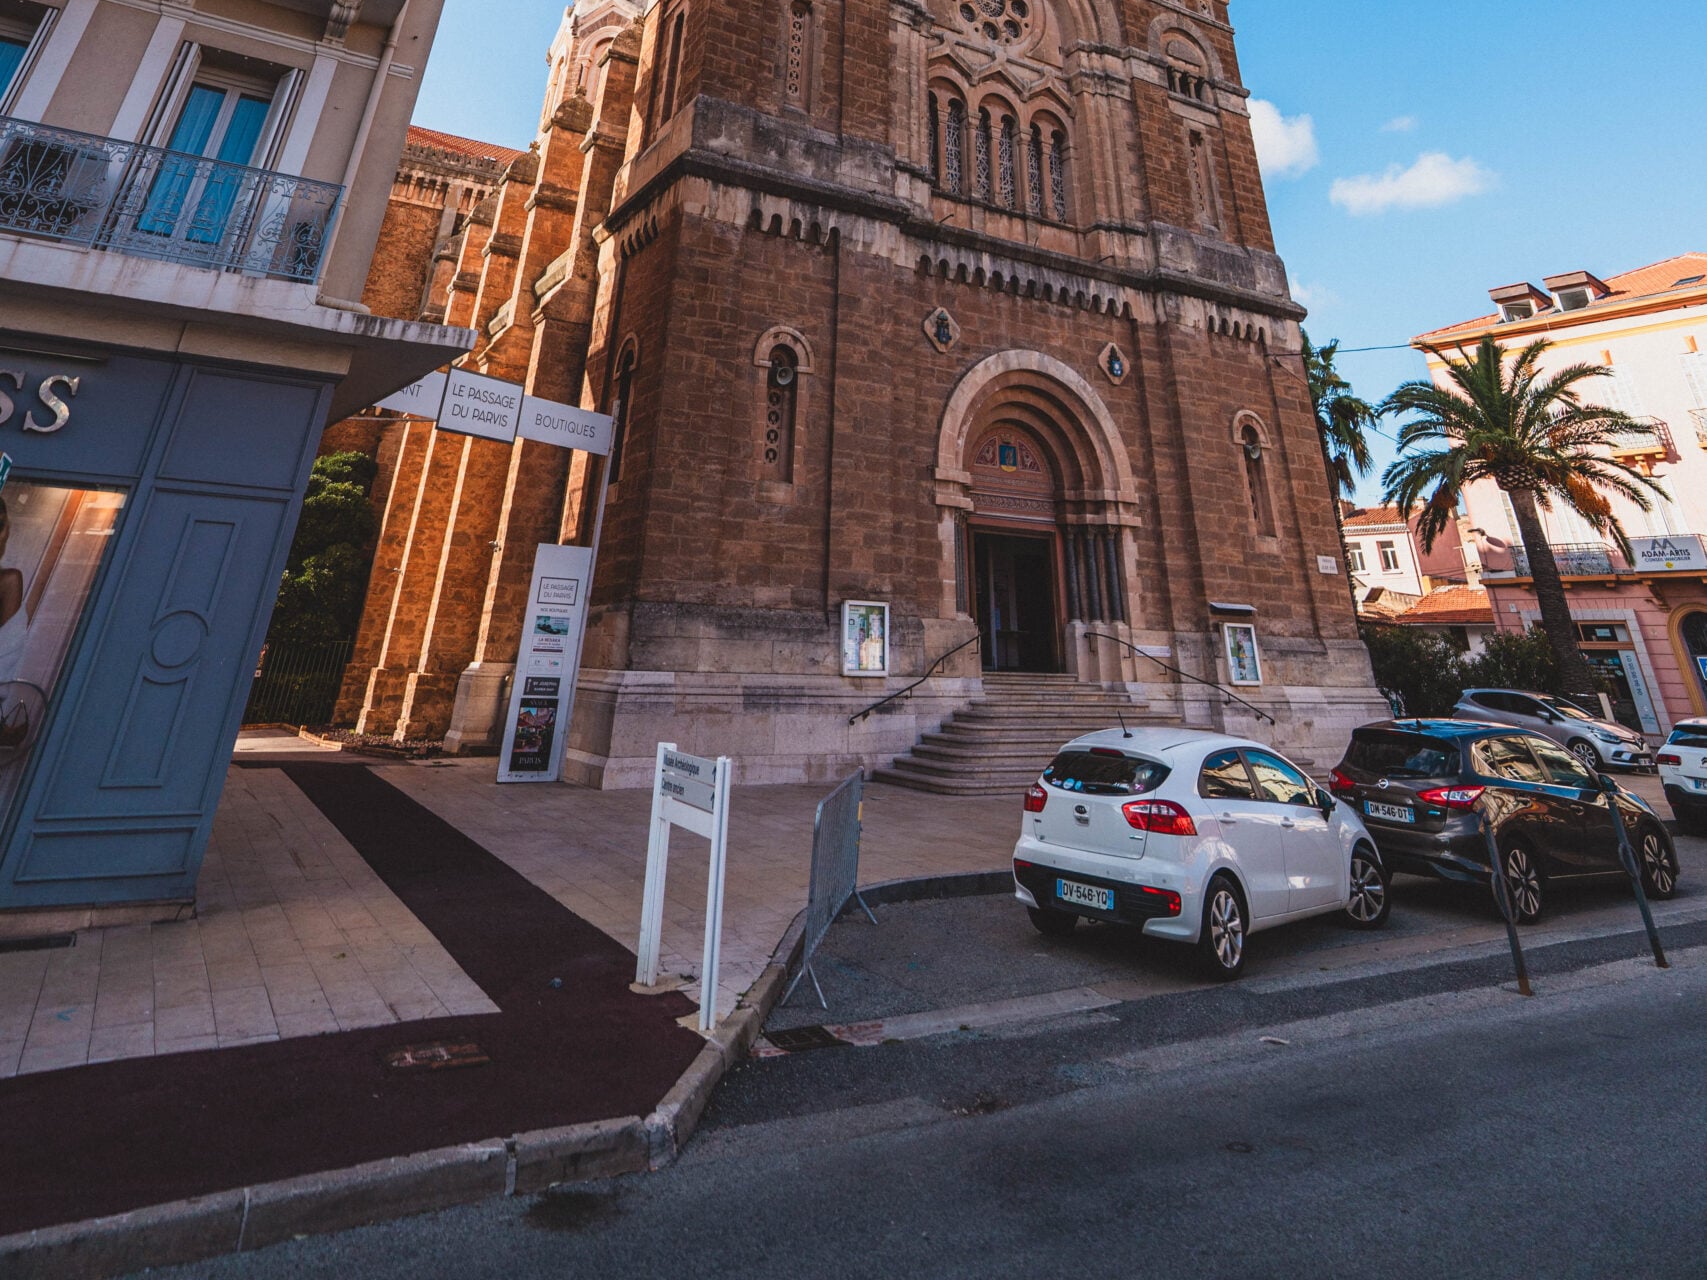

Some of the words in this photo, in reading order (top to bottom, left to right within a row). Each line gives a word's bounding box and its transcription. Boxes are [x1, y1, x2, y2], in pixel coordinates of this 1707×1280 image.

[452, 383, 465, 398] LE
[468, 387, 516, 410] PASSAGE
[451, 403, 469, 418] DU
[472, 408, 508, 428] PARVIS
[535, 413, 596, 439] BOUTIQUES
[1641, 549, 1691, 558] ADAM-ARTIS
[550, 584, 575, 592] PASSAGE
